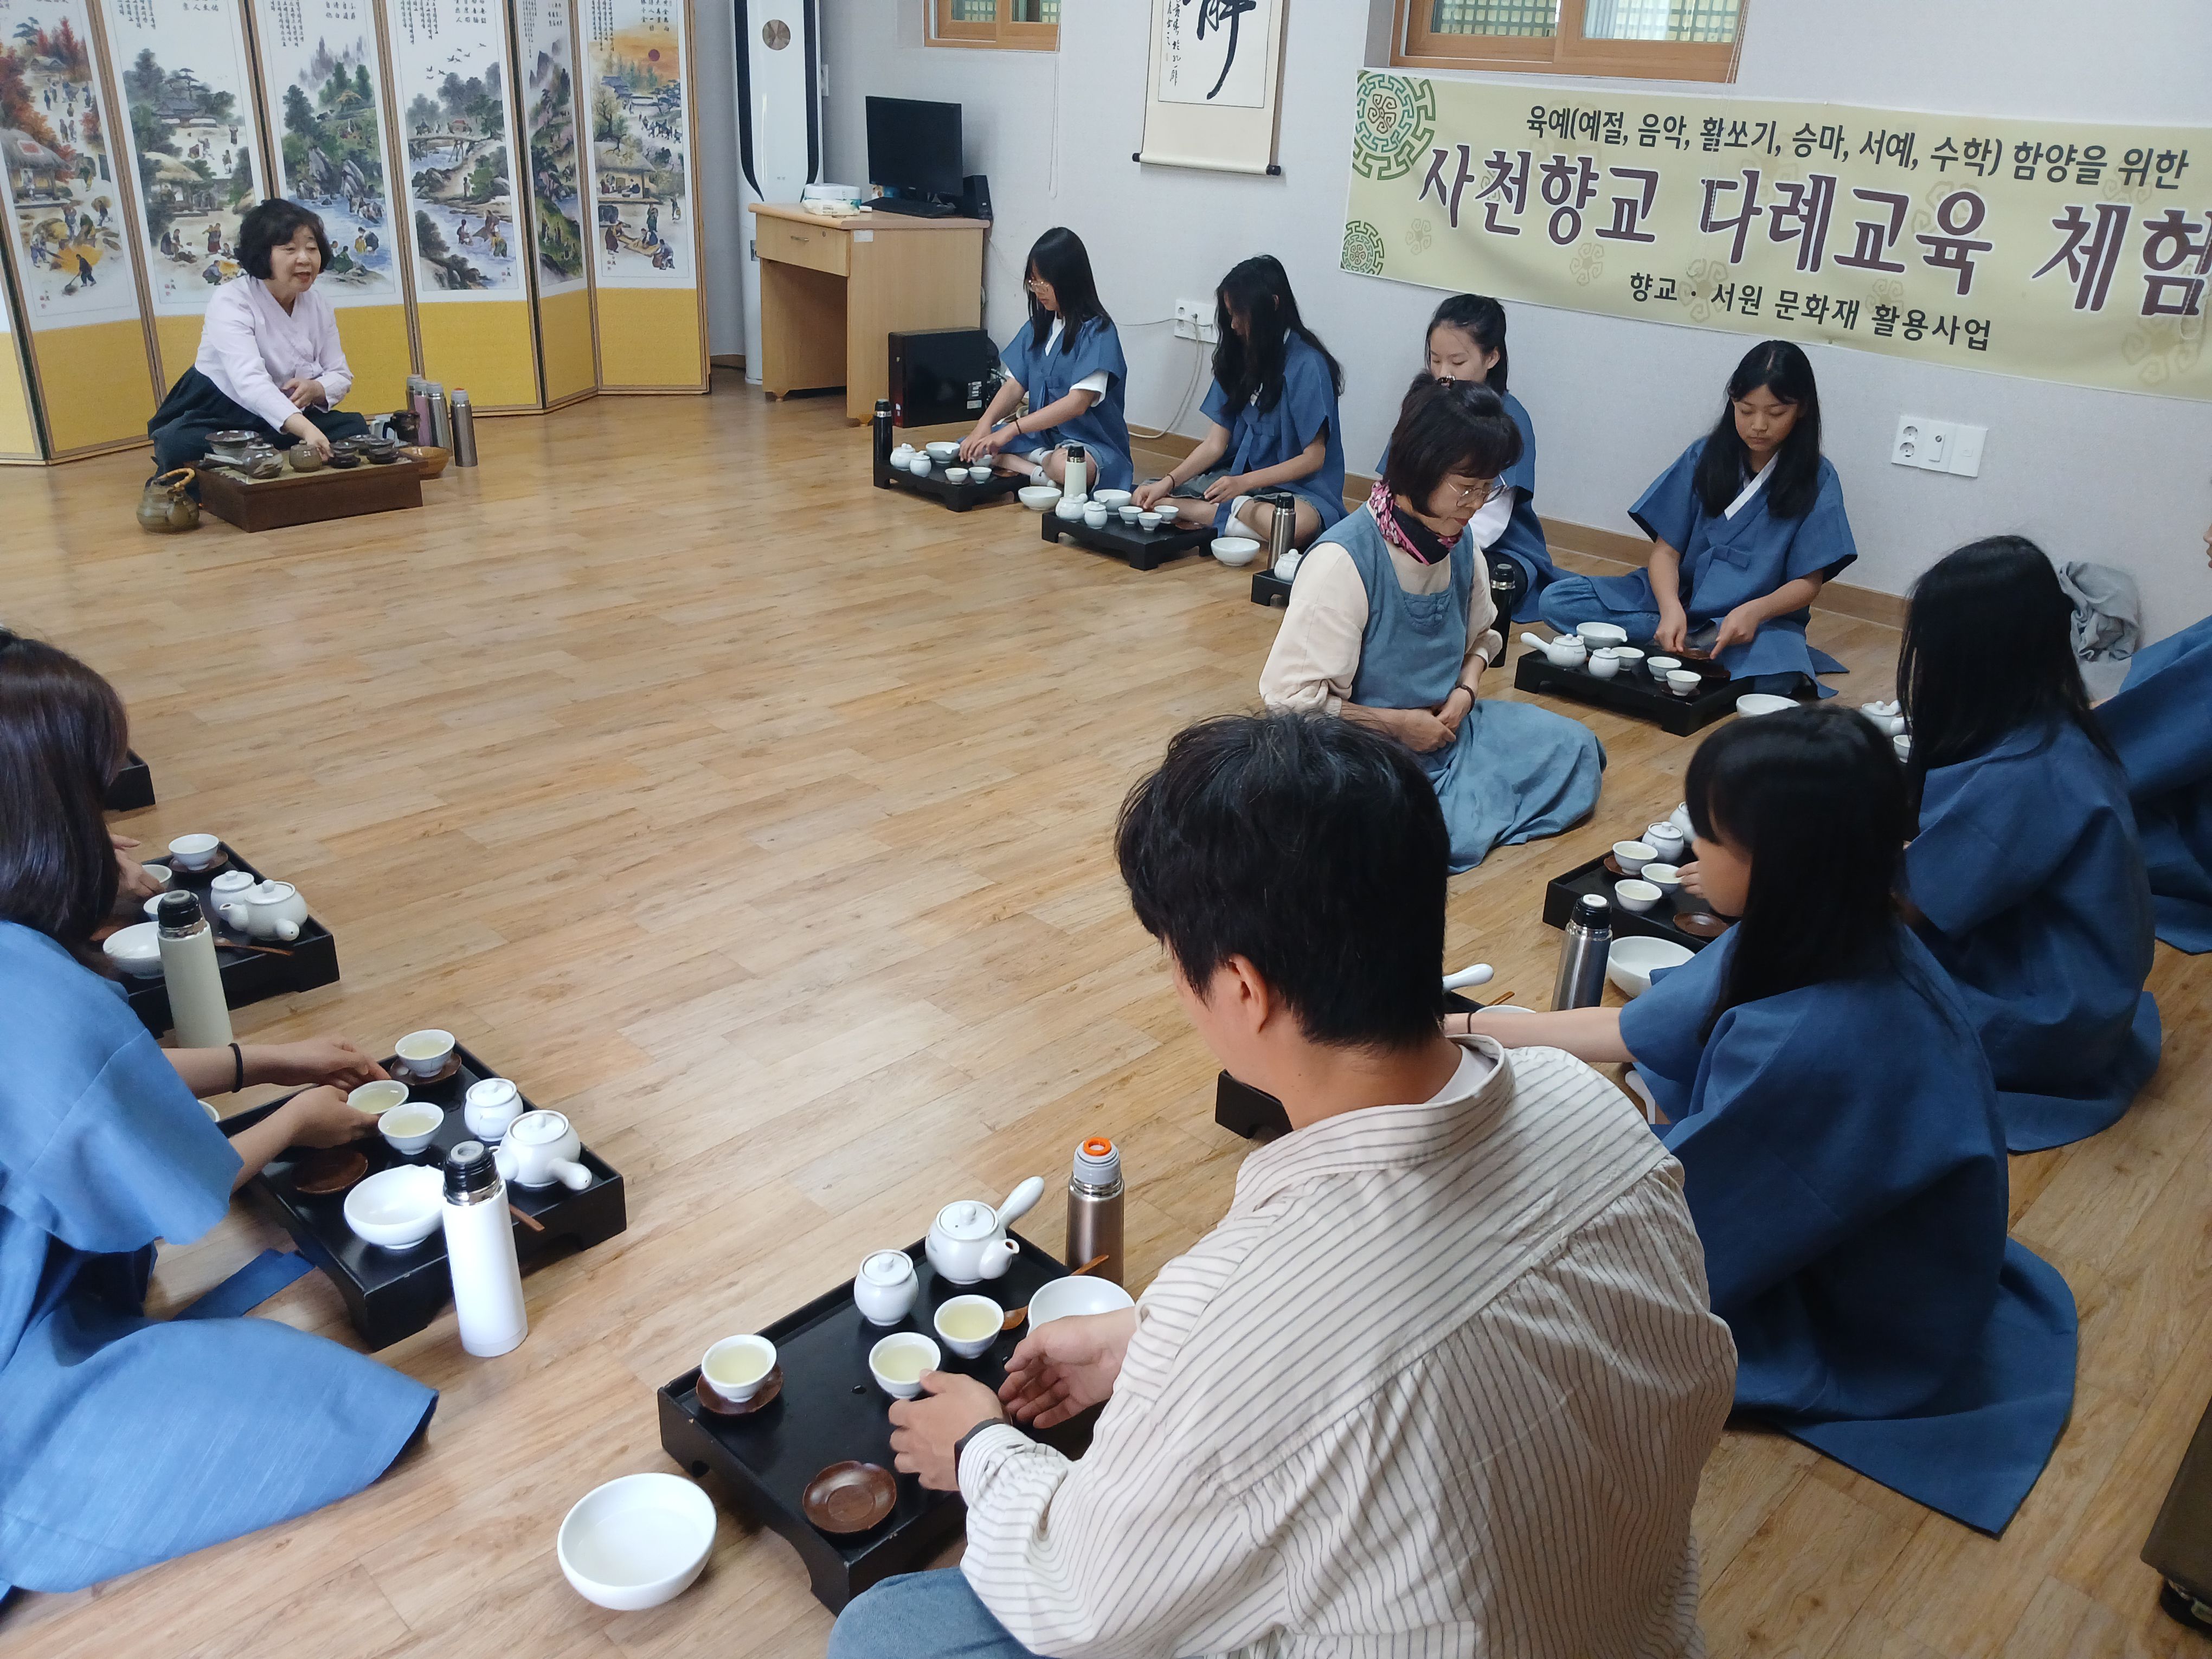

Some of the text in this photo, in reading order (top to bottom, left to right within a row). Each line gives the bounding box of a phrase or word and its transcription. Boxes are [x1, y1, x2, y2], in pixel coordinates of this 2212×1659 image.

[1638, 113, 1690, 151] 음악,
[1700, 117, 1781, 157] 활쏘기,
[1792, 123, 1849, 163] 승마,
[1859, 129, 1918, 171] 서예,
[1930, 137, 2002, 177] 수학)
[2014, 141, 2107, 185] 함양을
[2118, 148, 2189, 190] 위한
[1419, 144, 2212, 316] 사천향교 다례교육 체험
[1630, 272, 1677, 302] 향교
[1711, 283, 1763, 316] 서원
[1774, 290, 1860, 330] 문화재
[1871, 304, 1991, 351] 활용사업
